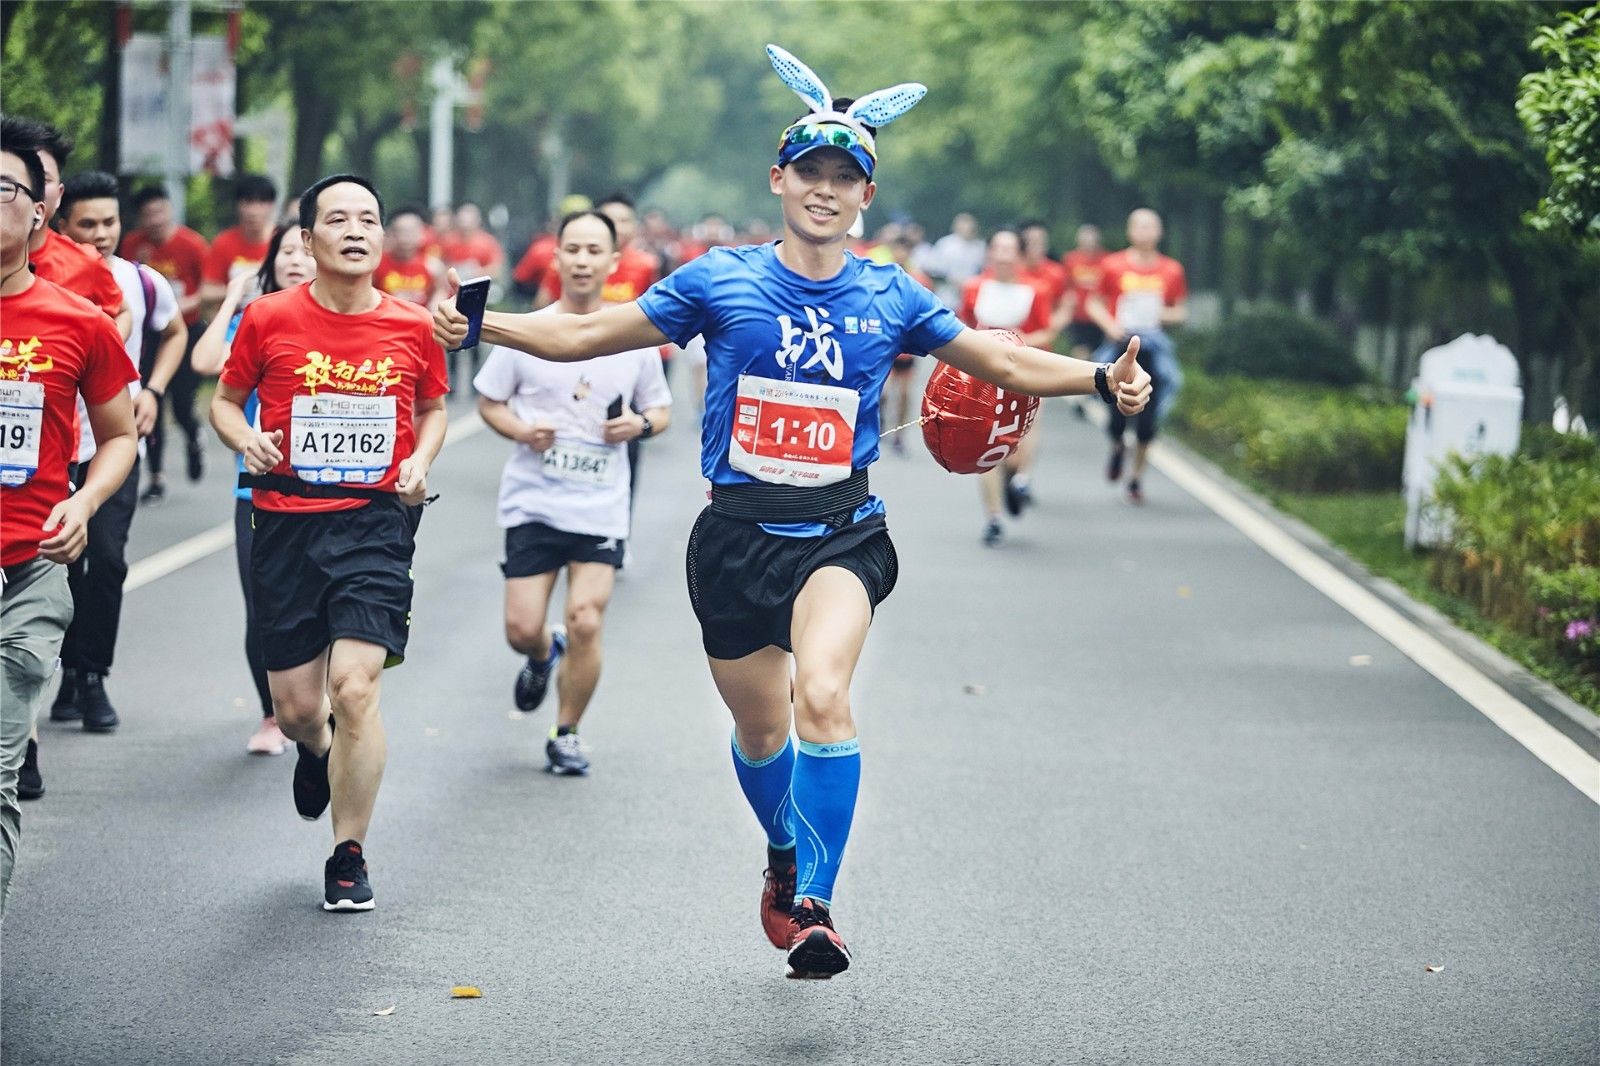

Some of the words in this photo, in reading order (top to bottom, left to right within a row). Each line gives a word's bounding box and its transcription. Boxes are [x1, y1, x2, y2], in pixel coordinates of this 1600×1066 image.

[775, 306, 844, 381] 战
[0, 424, 25, 449] 19
[301, 431, 385, 453] A12162
[771, 417, 836, 451] 1:10
